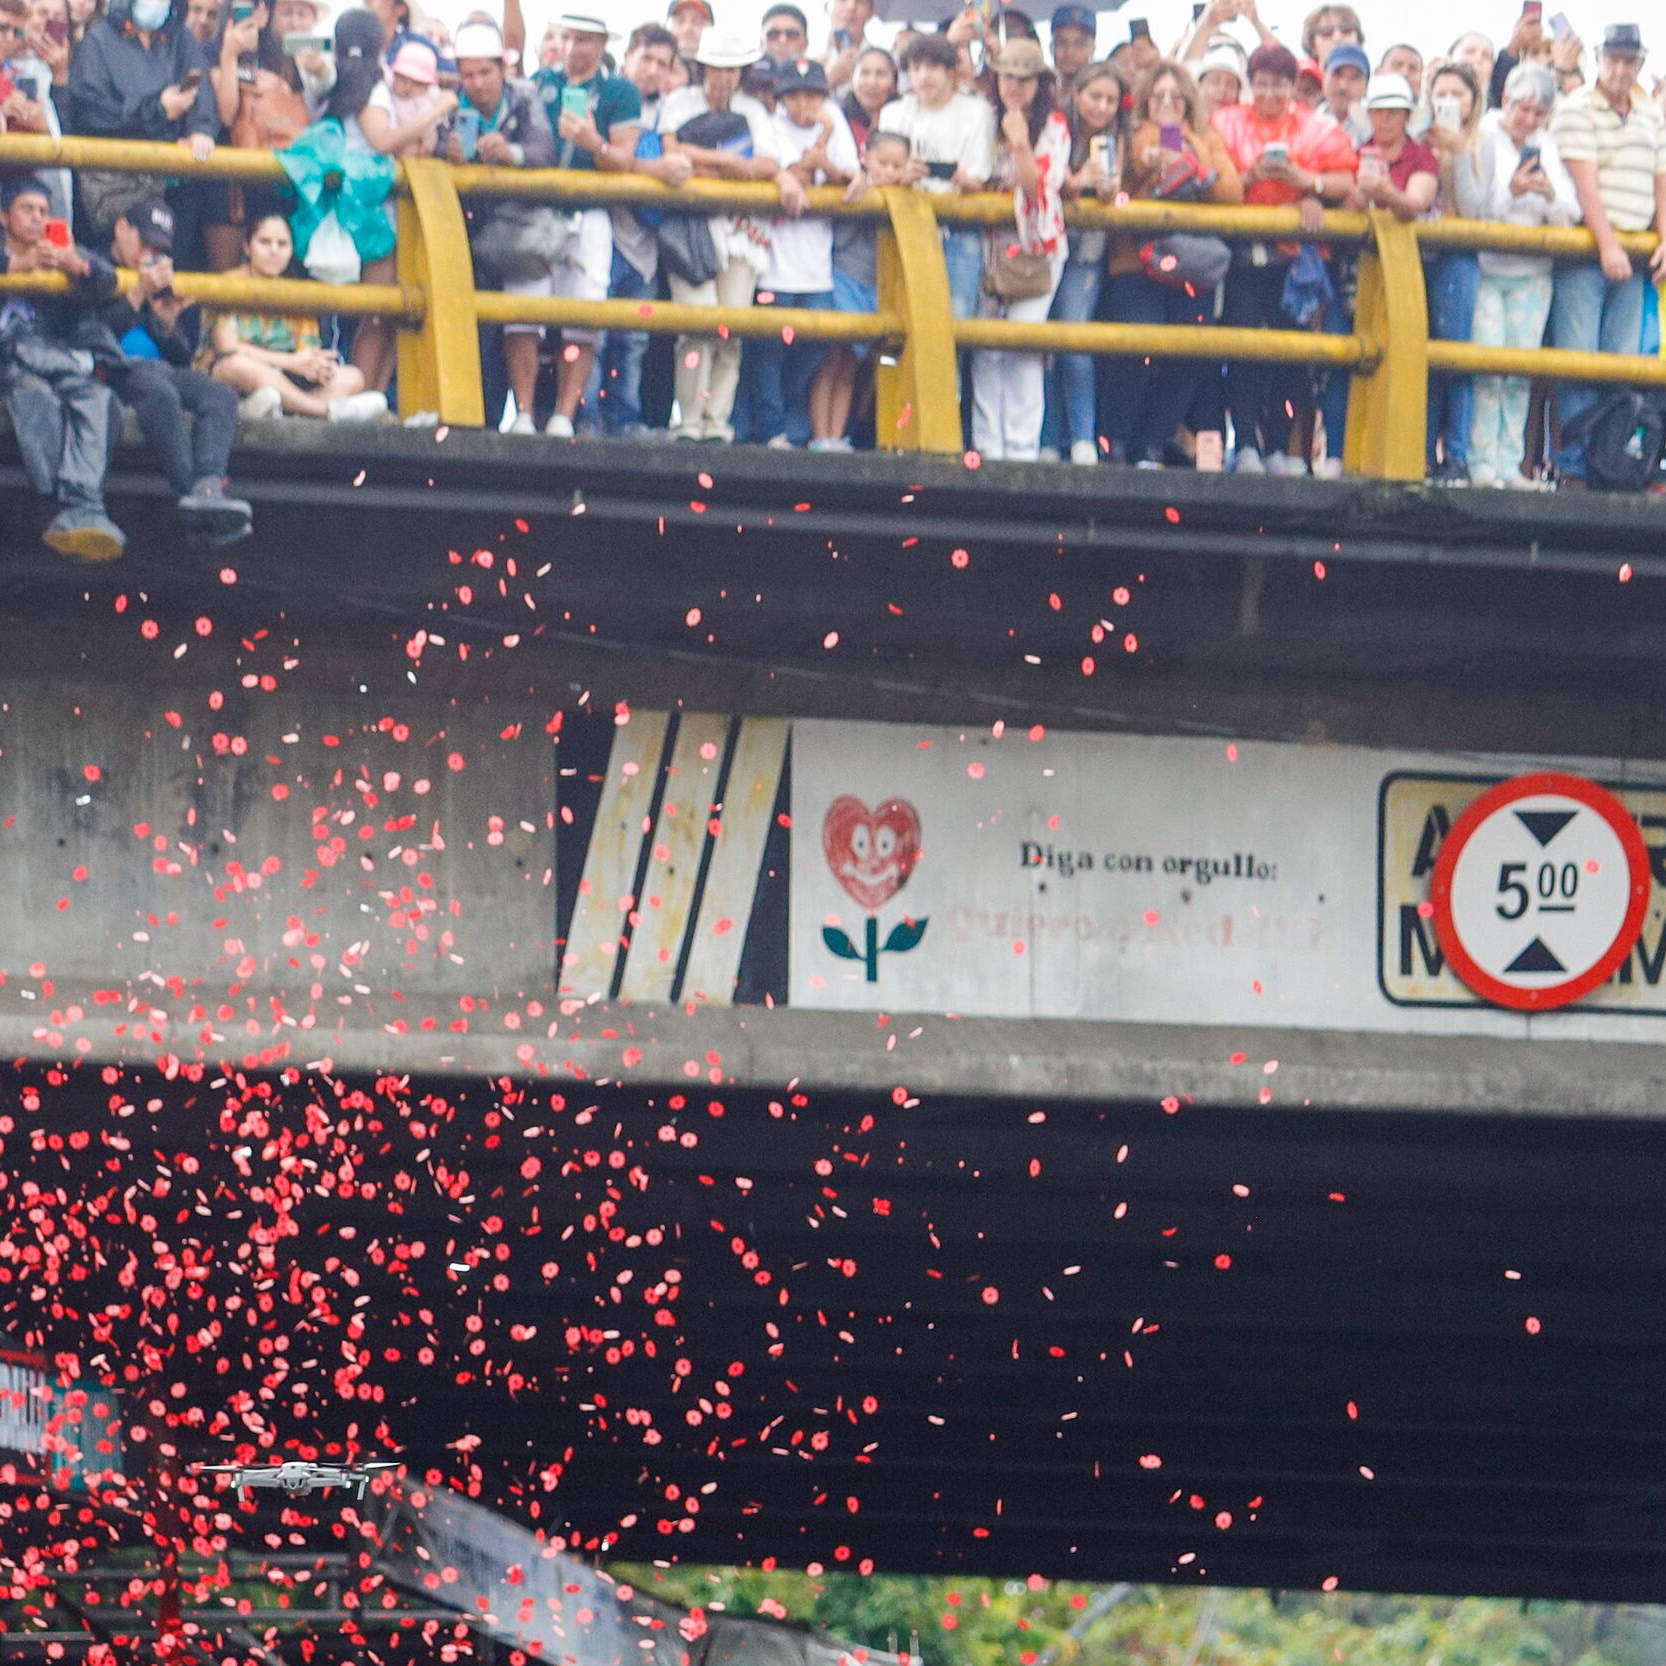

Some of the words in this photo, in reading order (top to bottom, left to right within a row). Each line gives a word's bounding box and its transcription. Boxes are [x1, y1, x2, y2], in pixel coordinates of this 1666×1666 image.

[1020, 840, 1095, 877] Diga
[1103, 851, 1153, 873] con
[1162, 852, 1277, 885] orgullo:
